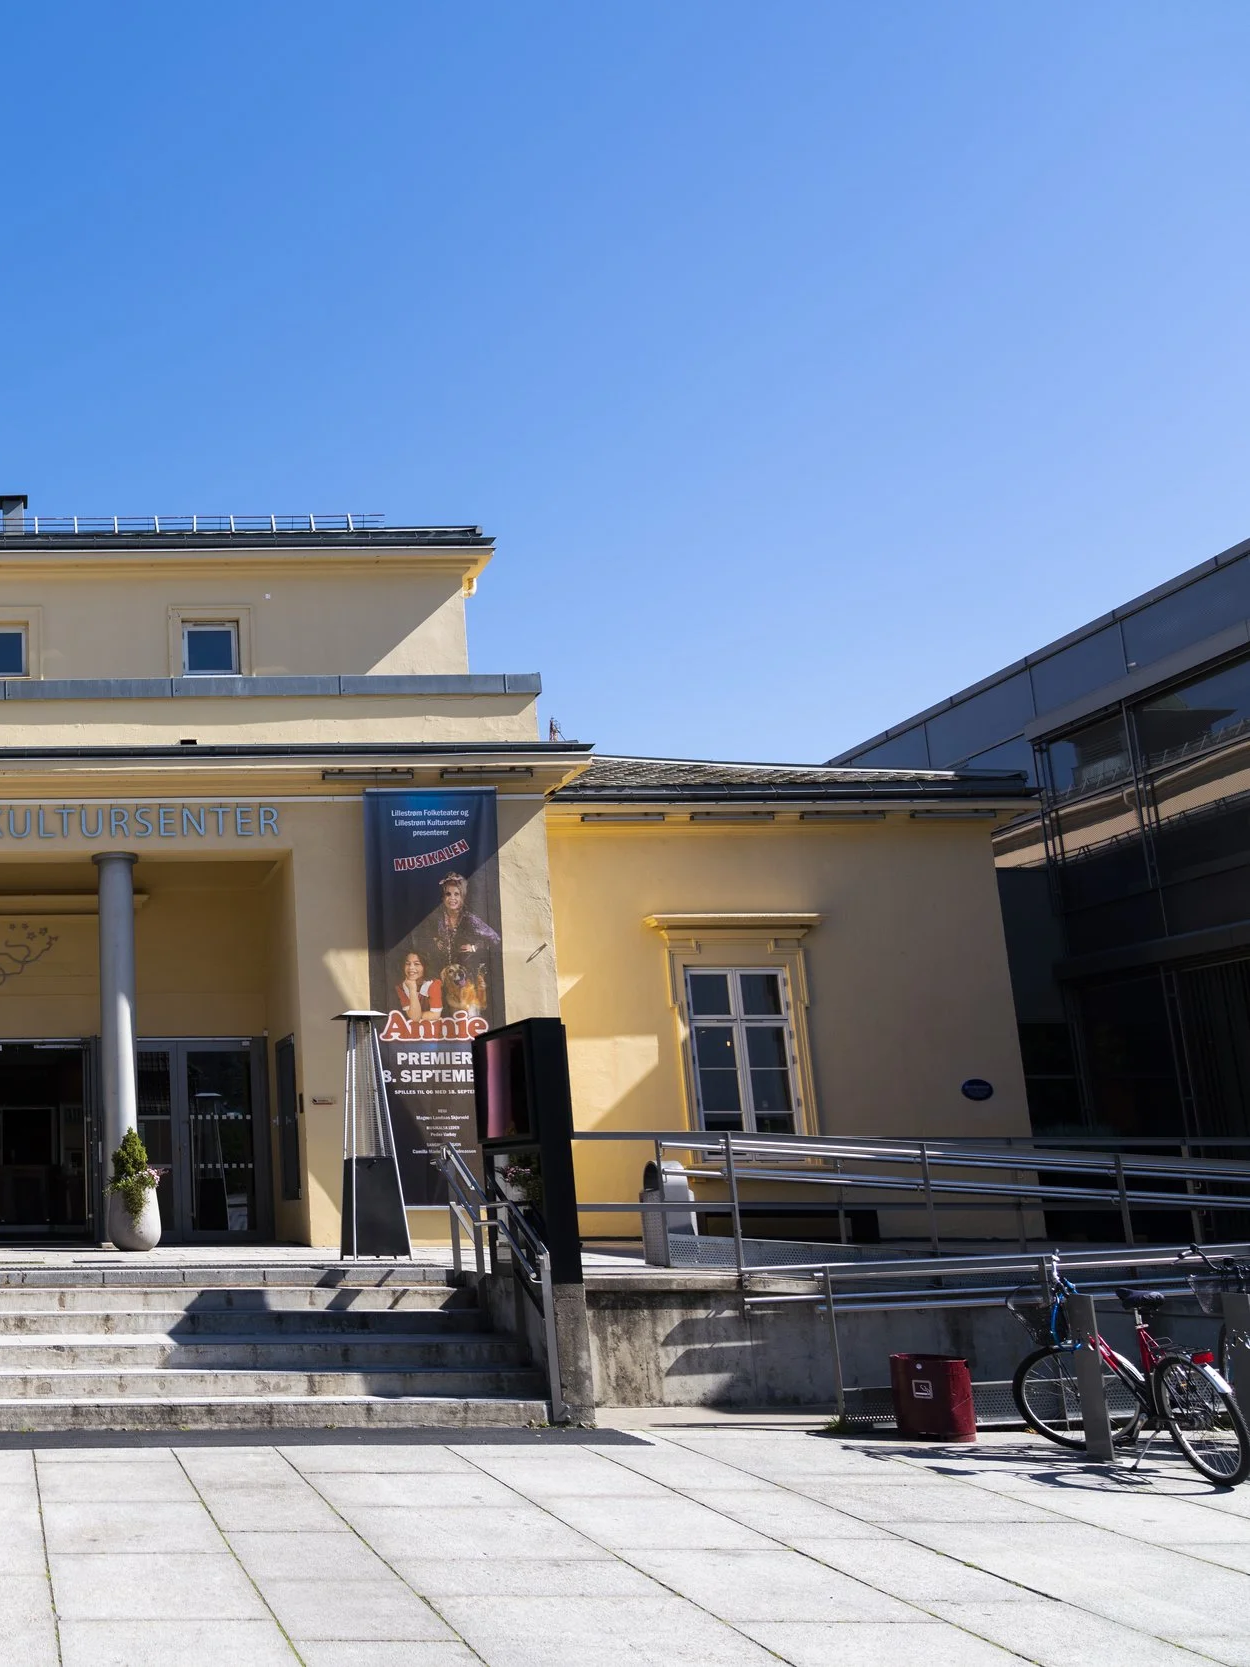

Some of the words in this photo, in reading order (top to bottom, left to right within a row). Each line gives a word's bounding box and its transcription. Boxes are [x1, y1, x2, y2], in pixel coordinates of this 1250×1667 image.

[393, 839, 470, 872] MUSIKALEN
[380, 1010, 489, 1042] Annie
[397, 1051, 473, 1065] PREMIER
